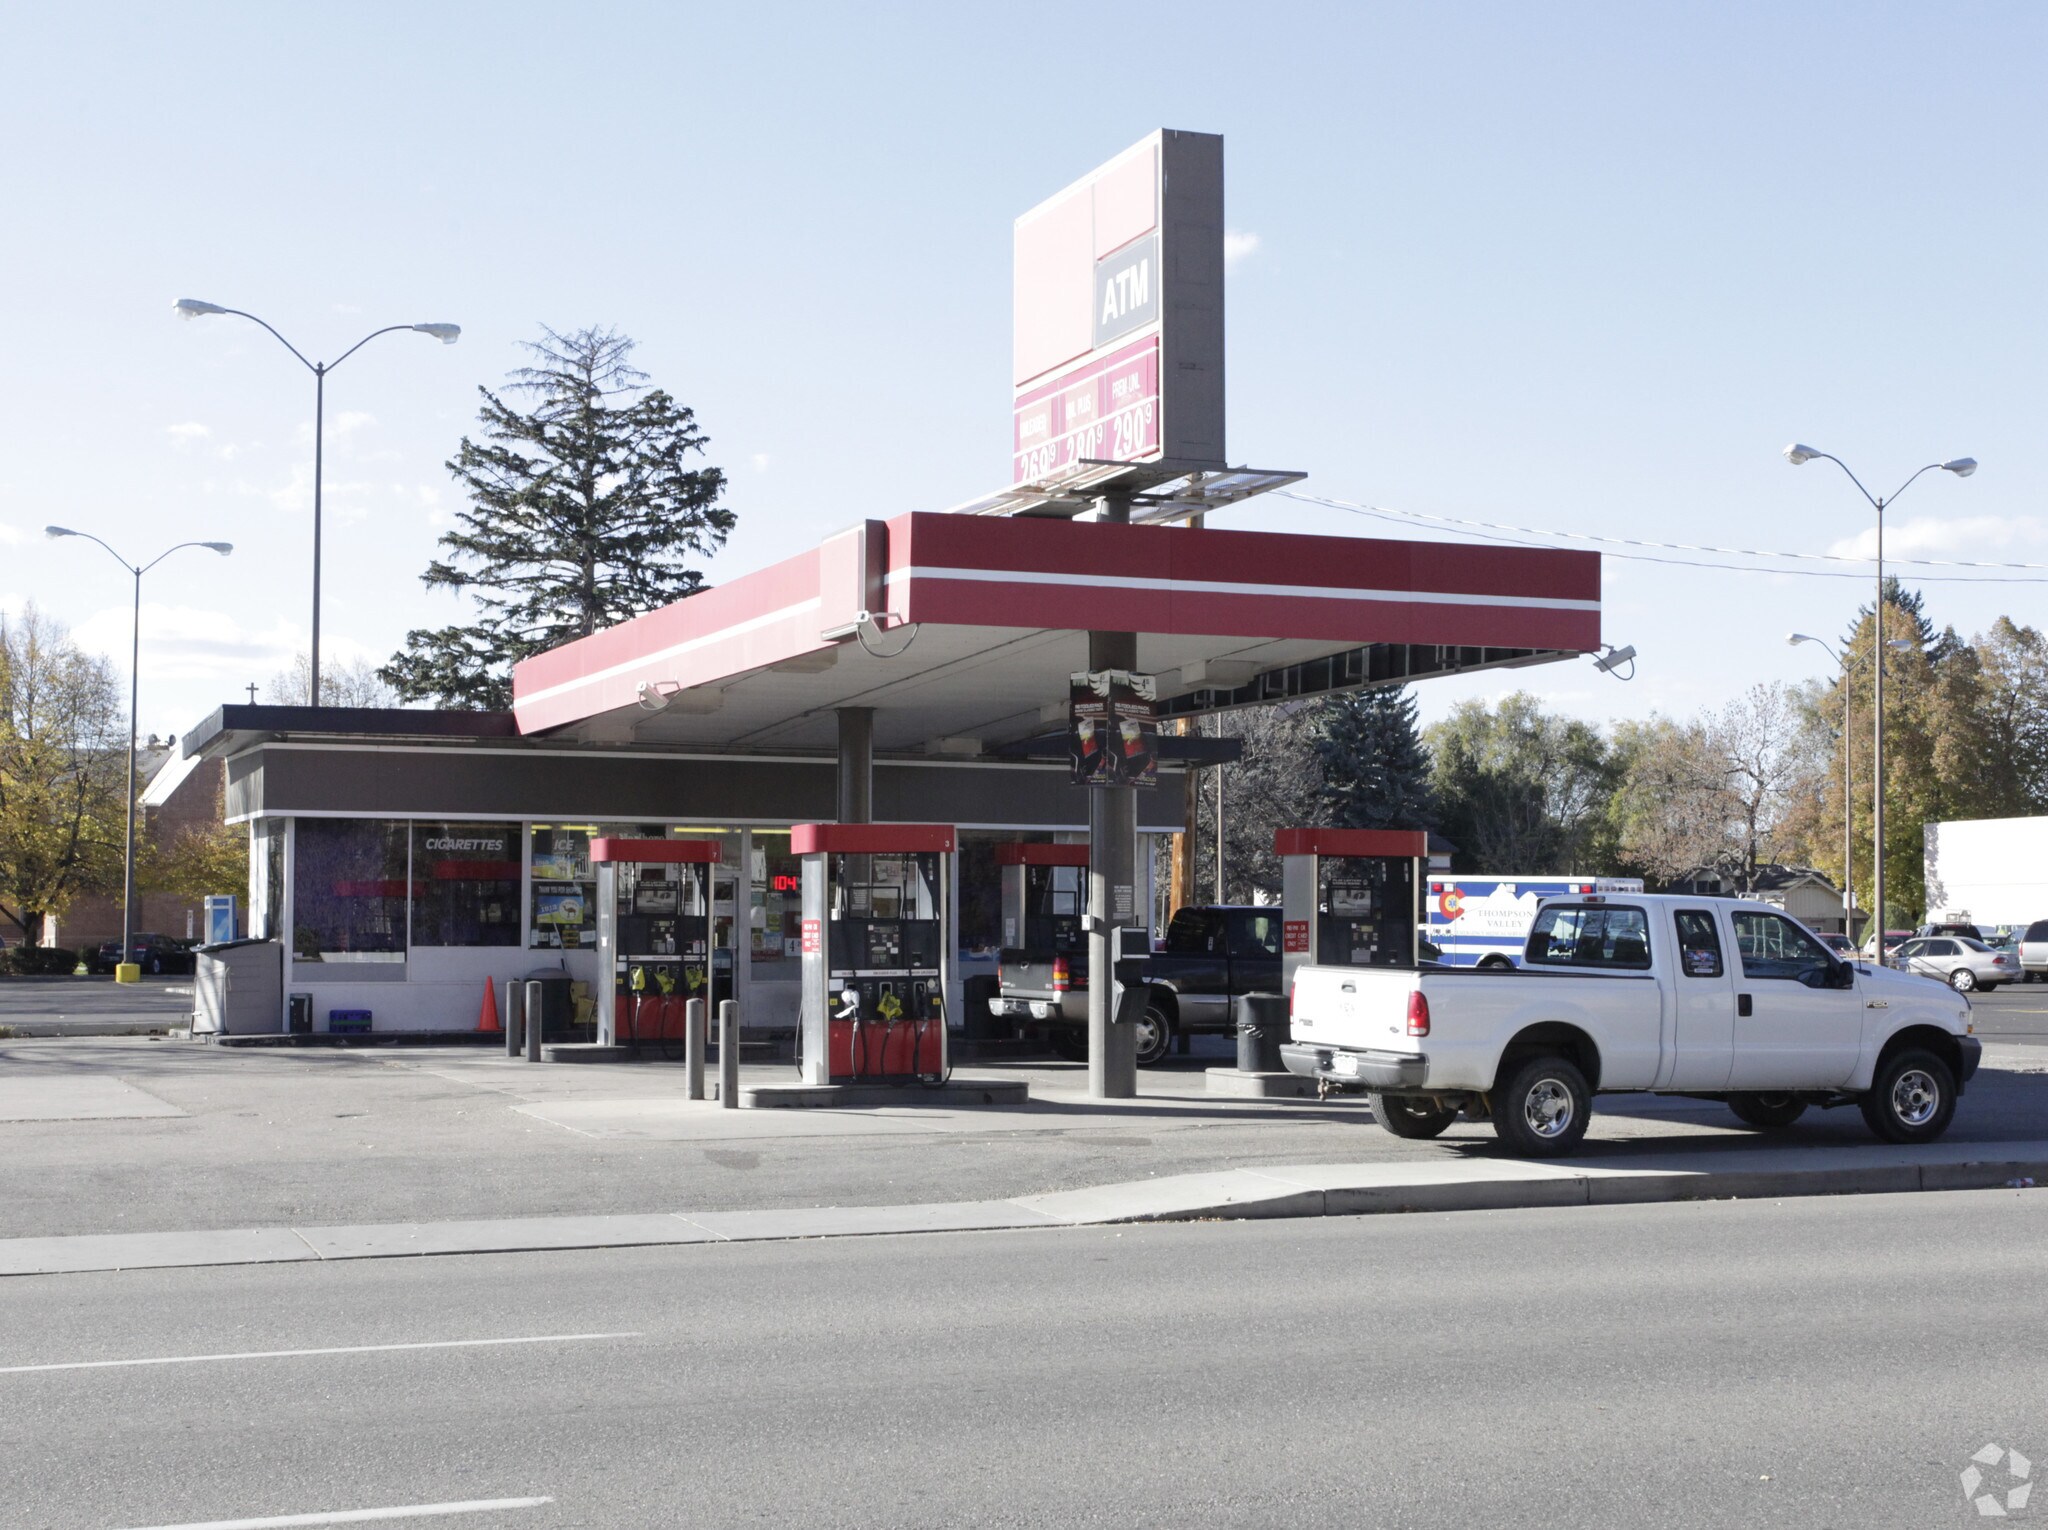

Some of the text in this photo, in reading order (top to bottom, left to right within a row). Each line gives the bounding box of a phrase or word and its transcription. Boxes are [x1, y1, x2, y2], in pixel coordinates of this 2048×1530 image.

[1102, 258, 1149, 325] ATM
[425, 838, 503, 851] CIGARETTES
[553, 839, 574, 851] ICE
[774, 875, 797, 891] 104
[1478, 909, 1534, 918] THOMPSON
[1487, 920, 1524, 928] VALLEY
